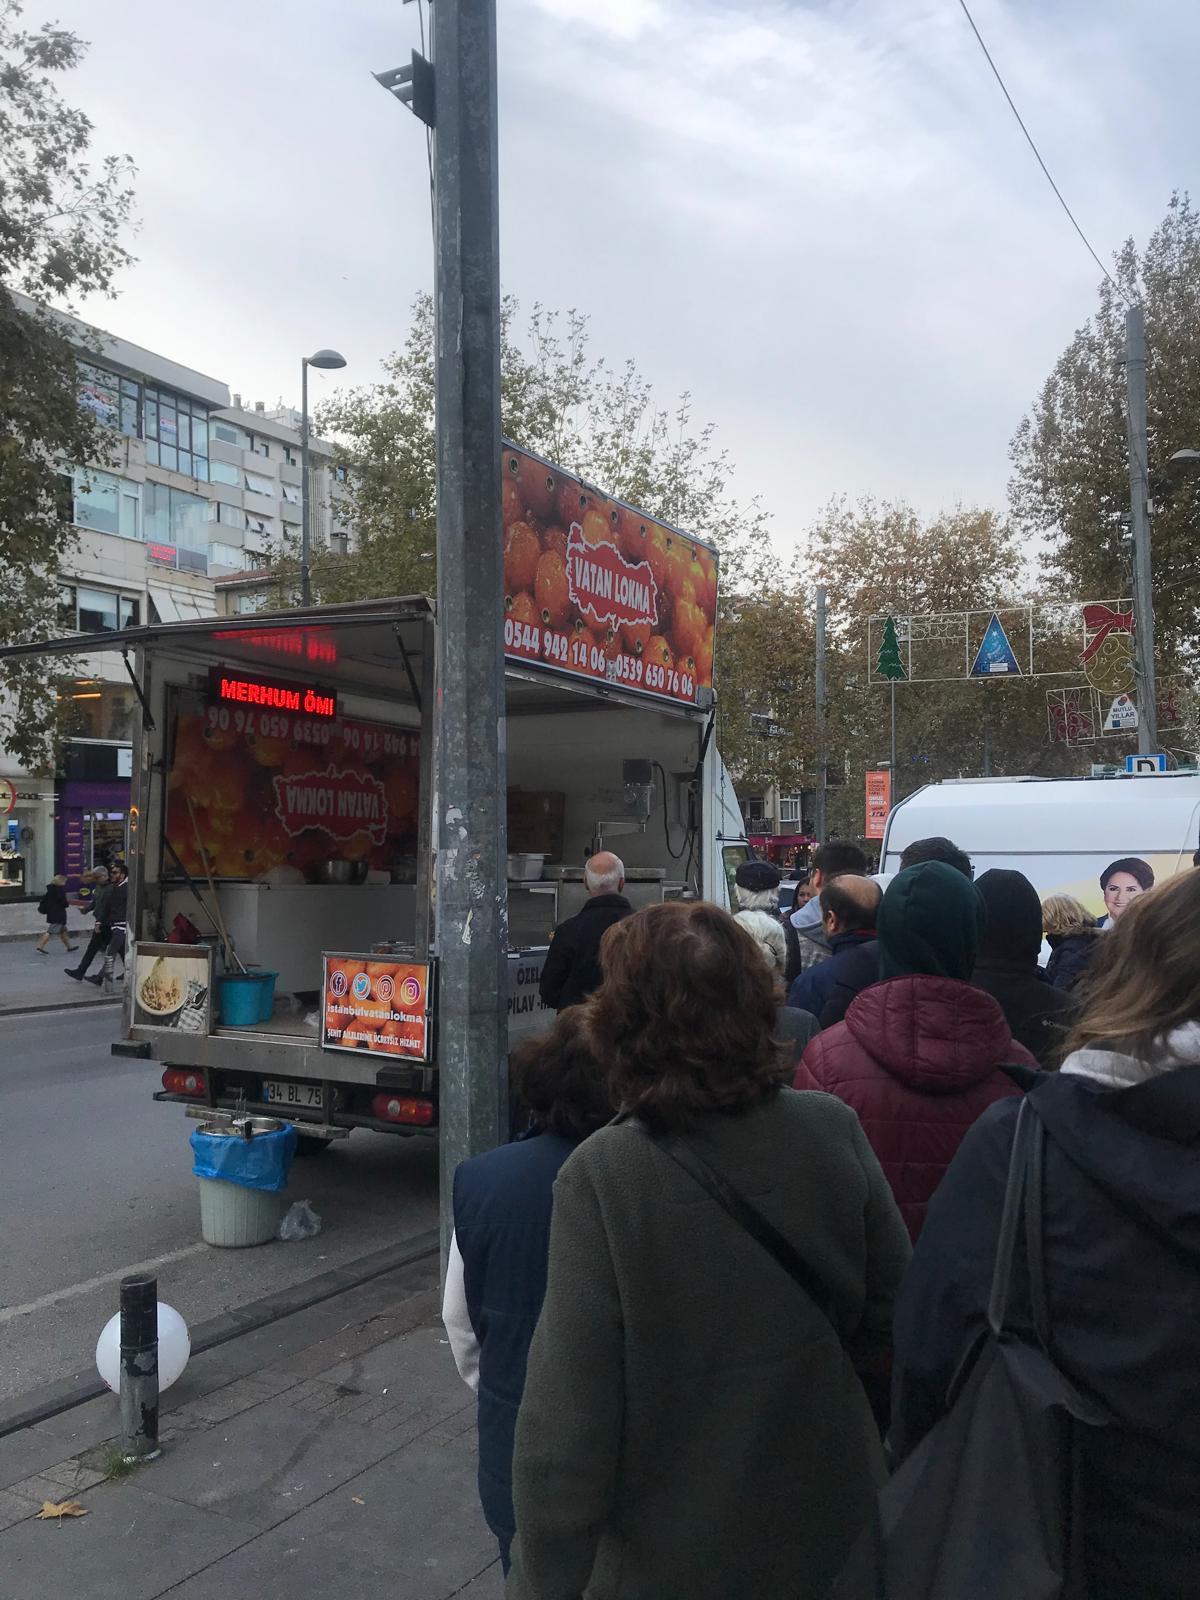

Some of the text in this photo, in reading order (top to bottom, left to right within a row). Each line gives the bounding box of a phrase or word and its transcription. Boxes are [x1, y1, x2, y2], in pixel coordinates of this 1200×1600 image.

[575, 557, 651, 615] VATAN LOKMA
[504, 619, 693, 696] 0544 942 14 06 0539 650 76 06
[220, 679, 300, 710] MERHUM
[287, 785, 379, 818] VATAN LOKMA
[517, 963, 540, 985] ÖZEL
[507, 992, 535, 1015] PİLAV
[327, 1028, 342, 1038] ŞEHİT
[374, 1032, 399, 1046] ÜCRETSİZ
[400, 1036, 421, 1048] HİZMET
[269, 1083, 283, 1100] 34
[288, 1085, 301, 1102] BL
